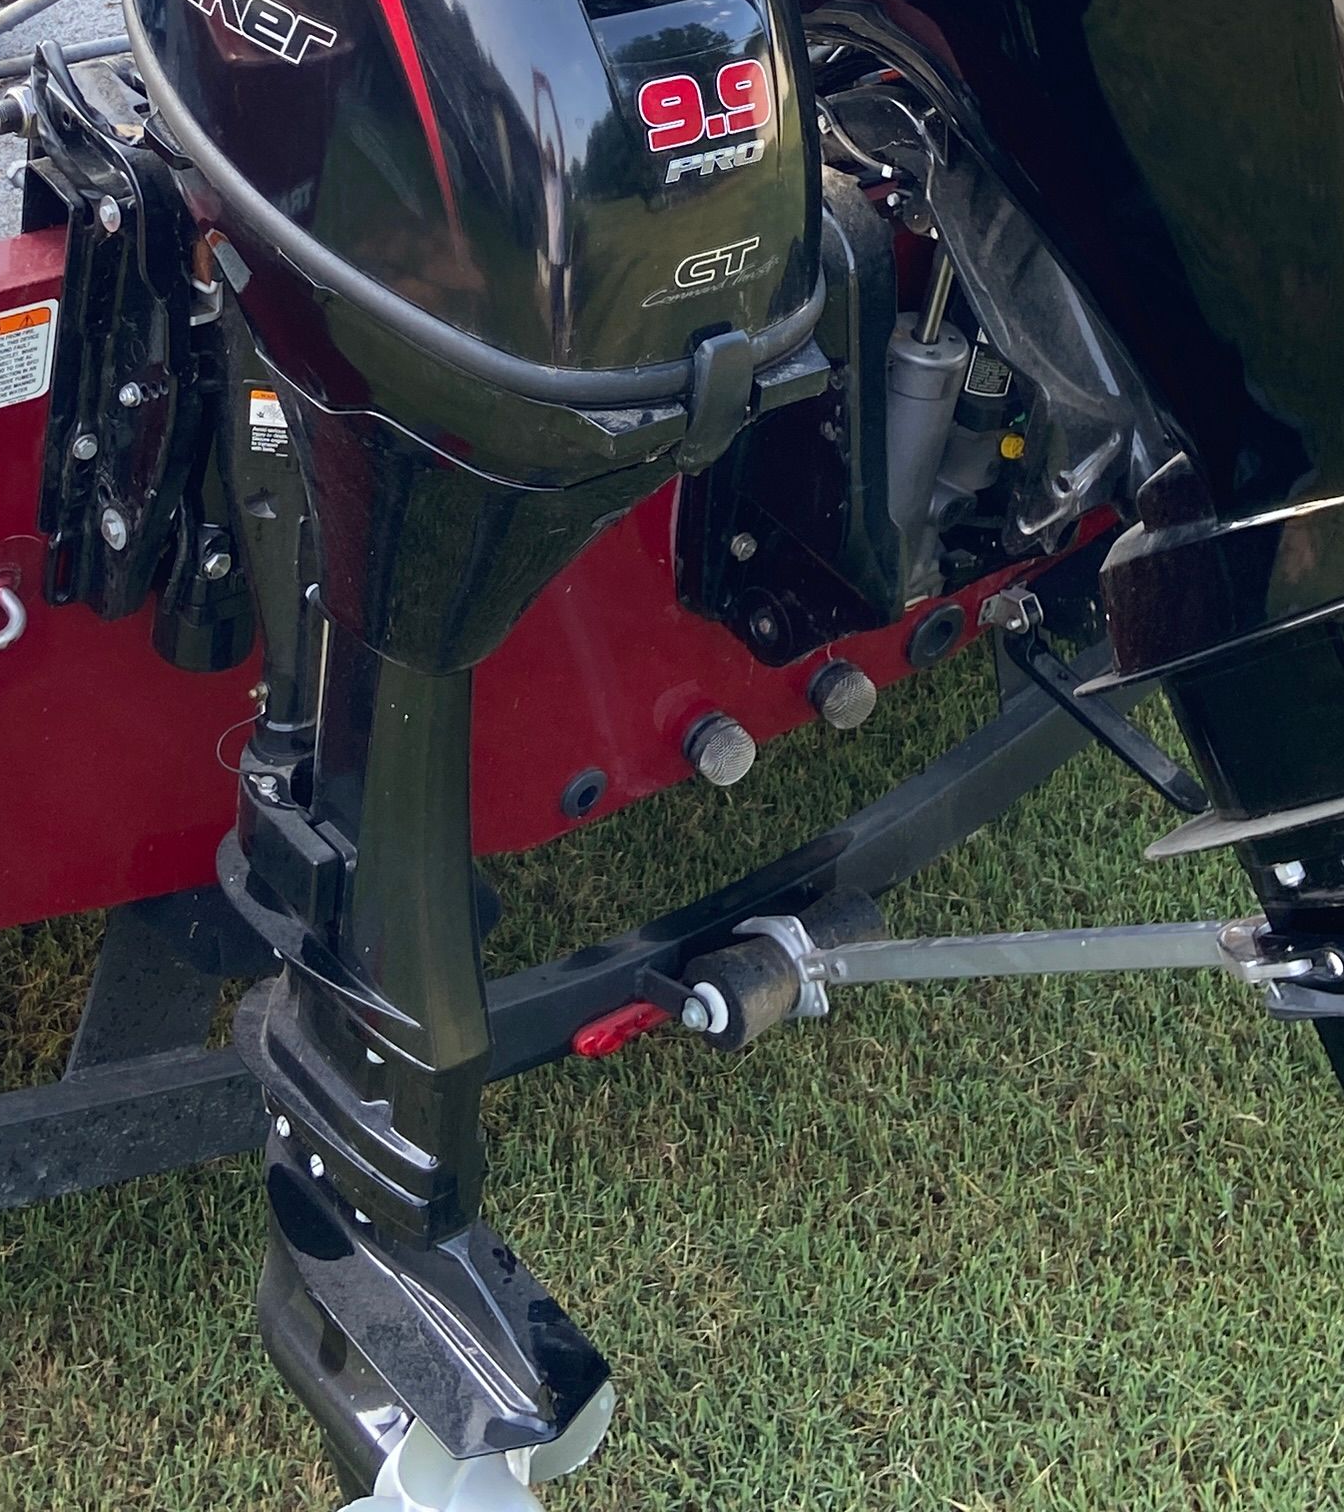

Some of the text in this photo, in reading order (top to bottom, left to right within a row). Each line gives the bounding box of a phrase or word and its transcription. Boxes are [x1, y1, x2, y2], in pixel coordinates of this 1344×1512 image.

[637, 58, 772, 152] 9.9
[665, 139, 766, 184] PRO
[674, 236, 761, 288] CT
